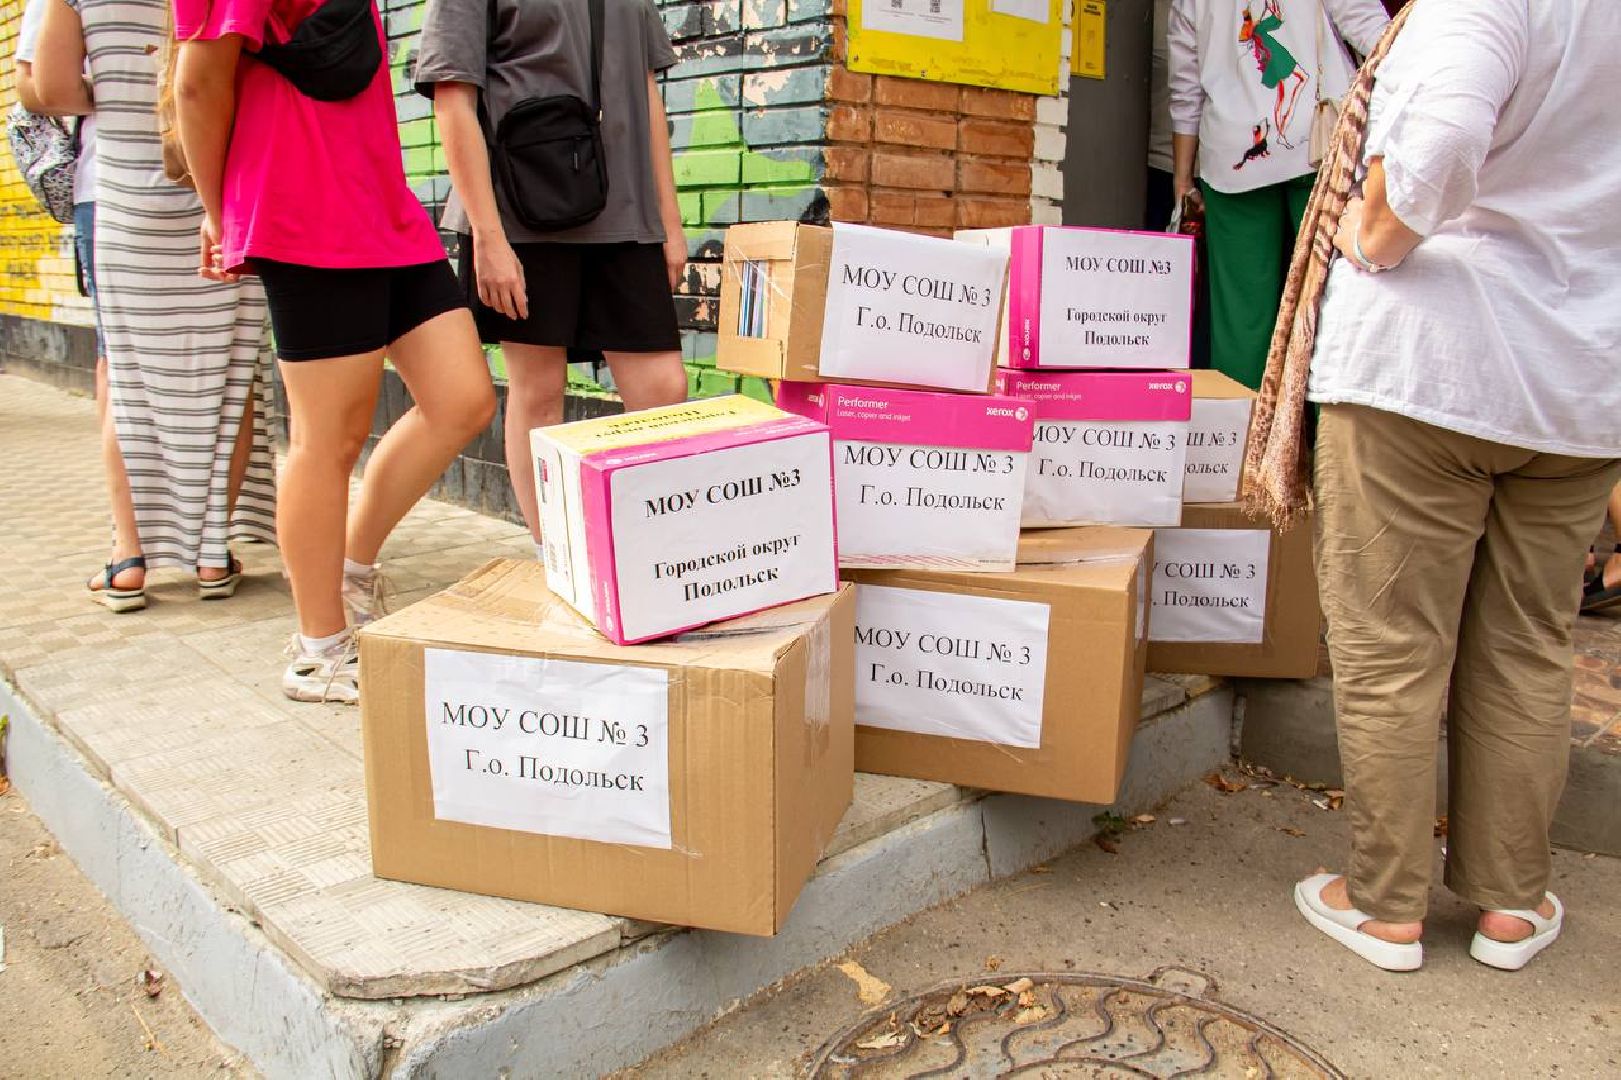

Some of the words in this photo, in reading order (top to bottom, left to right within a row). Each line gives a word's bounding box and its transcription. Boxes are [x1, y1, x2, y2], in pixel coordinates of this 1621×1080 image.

[1066, 256, 1103, 273] МОУ
[1106, 257, 1145, 273] СОШ
[1149, 260, 1171, 274] №3
[842, 263, 896, 291] МОУ
[902, 275, 954, 302] СОШ
[958, 283, 978, 307] №
[981, 287, 991, 307] 3
[856, 306, 891, 332] Г.о.
[899, 312, 983, 344] Подольск
[1066, 307, 1130, 325] Городской
[1133, 313, 1168, 326] округ
[1084, 330, 1150, 346] Подольск
[1017, 381, 1061, 391] Performer
[1149, 382, 1172, 390] xerox
[838, 395, 888, 409] Performer
[986, 407, 1013, 417] xerox
[1083, 428, 1133, 450] СОШ
[1138, 432, 1161, 450] №
[1166, 434, 1176, 451] 3
[1208, 432, 1225, 446] №
[1228, 432, 1237, 446] 3
[844, 444, 902, 468] МОУ
[910, 448, 967, 471] СОШ
[973, 453, 996, 474] №
[1000, 454, 1014, 474] 3
[1037, 458, 1072, 478] Г.о.
[1080, 461, 1168, 483] Подольск
[1184, 463, 1229, 475] ольск
[644, 489, 699, 518] МОУ
[706, 475, 763, 504] СОШ
[768, 467, 801, 492] №3
[860, 483, 898, 507] Г.о.
[906, 487, 1005, 511] Подольск
[654, 542, 748, 579] Городской
[752, 533, 801, 559] округ
[1165, 562, 1214, 579] СОШ
[1219, 563, 1241, 579] №
[1246, 563, 1256, 579] 3
[684, 566, 778, 602] Подольск
[1165, 590, 1250, 608] Подольск
[854, 625, 910, 650] МОУ
[918, 634, 980, 659] СОШ
[986, 642, 1012, 664] №
[1018, 645, 1031, 665] 3
[870, 663, 909, 687] Г.о.
[917, 670, 1024, 701] Подольск
[442, 701, 510, 730] МОУ
[519, 710, 591, 741] СОШ
[598, 719, 627, 745] №
[635, 724, 649, 748] 3
[464, 748, 510, 777] Г.о.
[519, 756, 644, 792] Подольск
